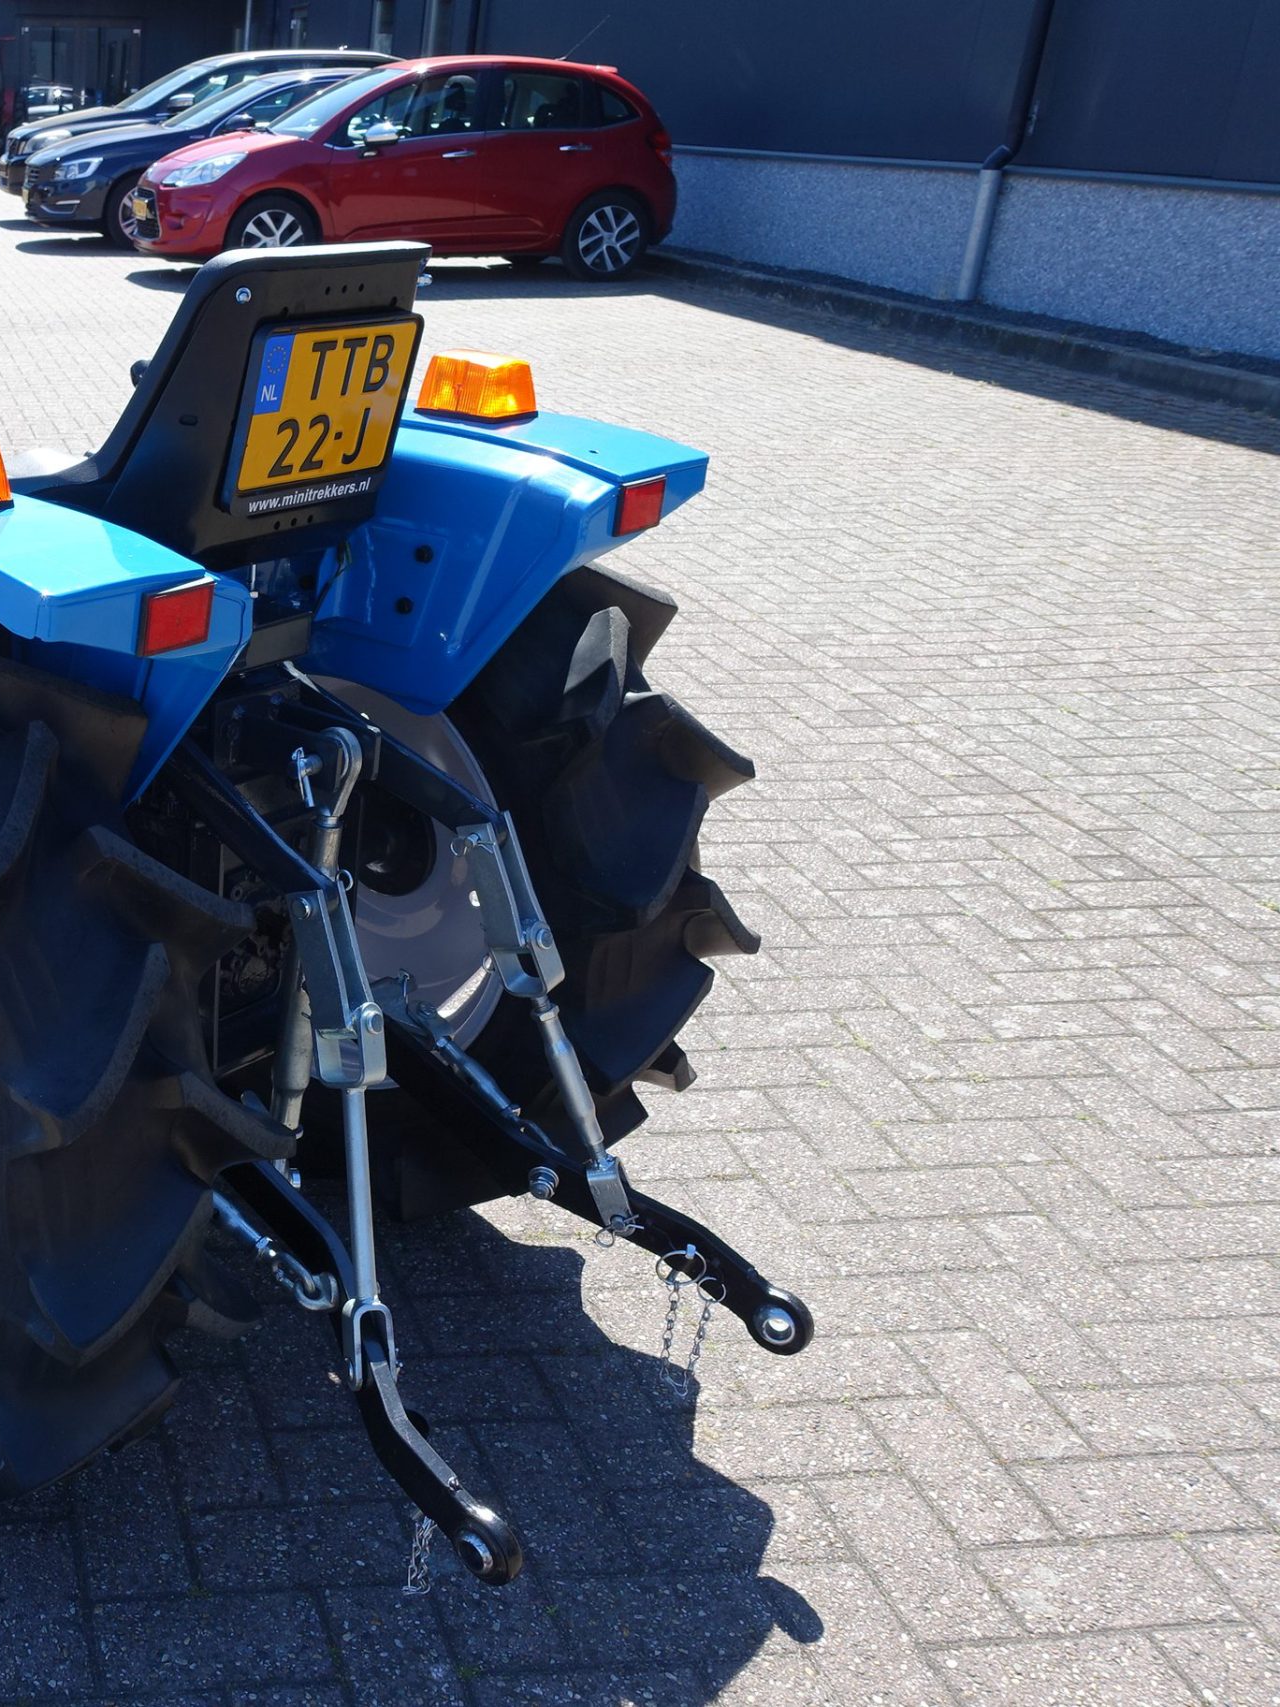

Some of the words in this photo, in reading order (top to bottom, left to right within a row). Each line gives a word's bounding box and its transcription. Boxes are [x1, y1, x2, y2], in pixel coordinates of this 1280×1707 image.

[311, 334, 395, 401] TTB
[260, 384, 278, 403] NL
[248, 477, 372, 512] www.minitrekkers.nl
